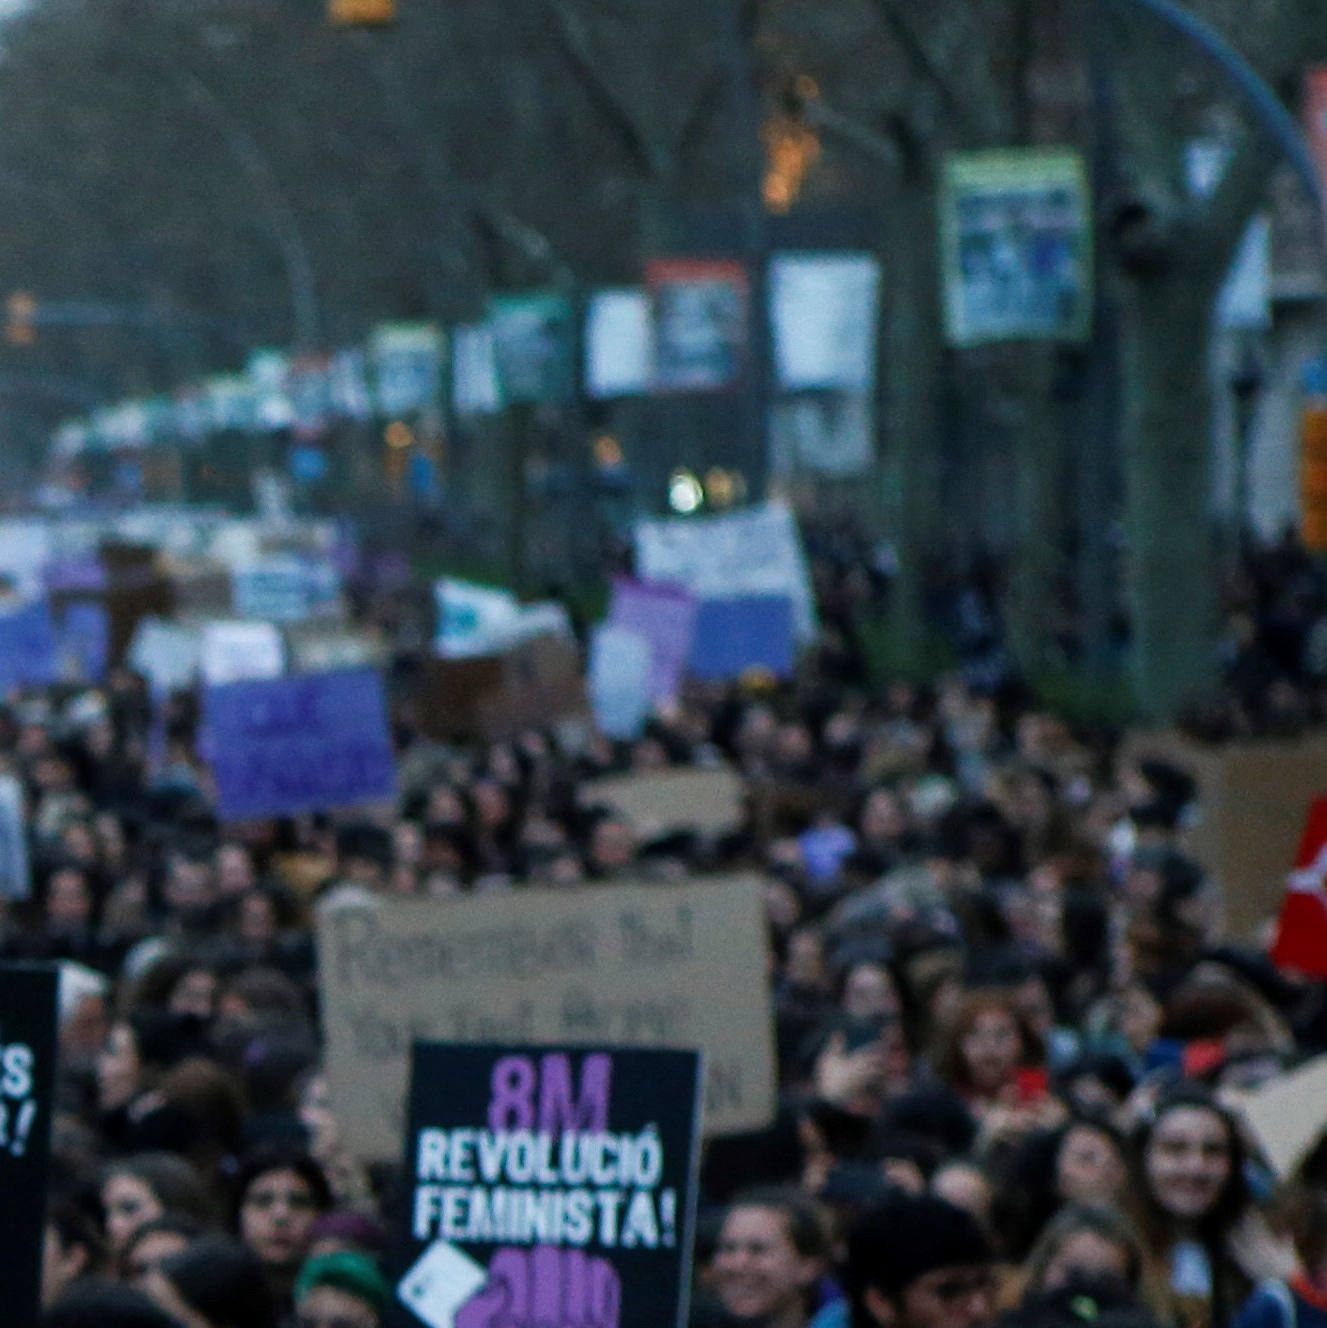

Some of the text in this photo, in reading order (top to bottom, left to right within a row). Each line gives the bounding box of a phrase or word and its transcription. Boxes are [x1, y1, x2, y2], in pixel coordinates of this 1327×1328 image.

[488, 1052, 613, 1135] 8M
[416, 1121, 663, 1187] REVOLUCIÓ
[411, 1183, 676, 1248] FEMINISTA!
